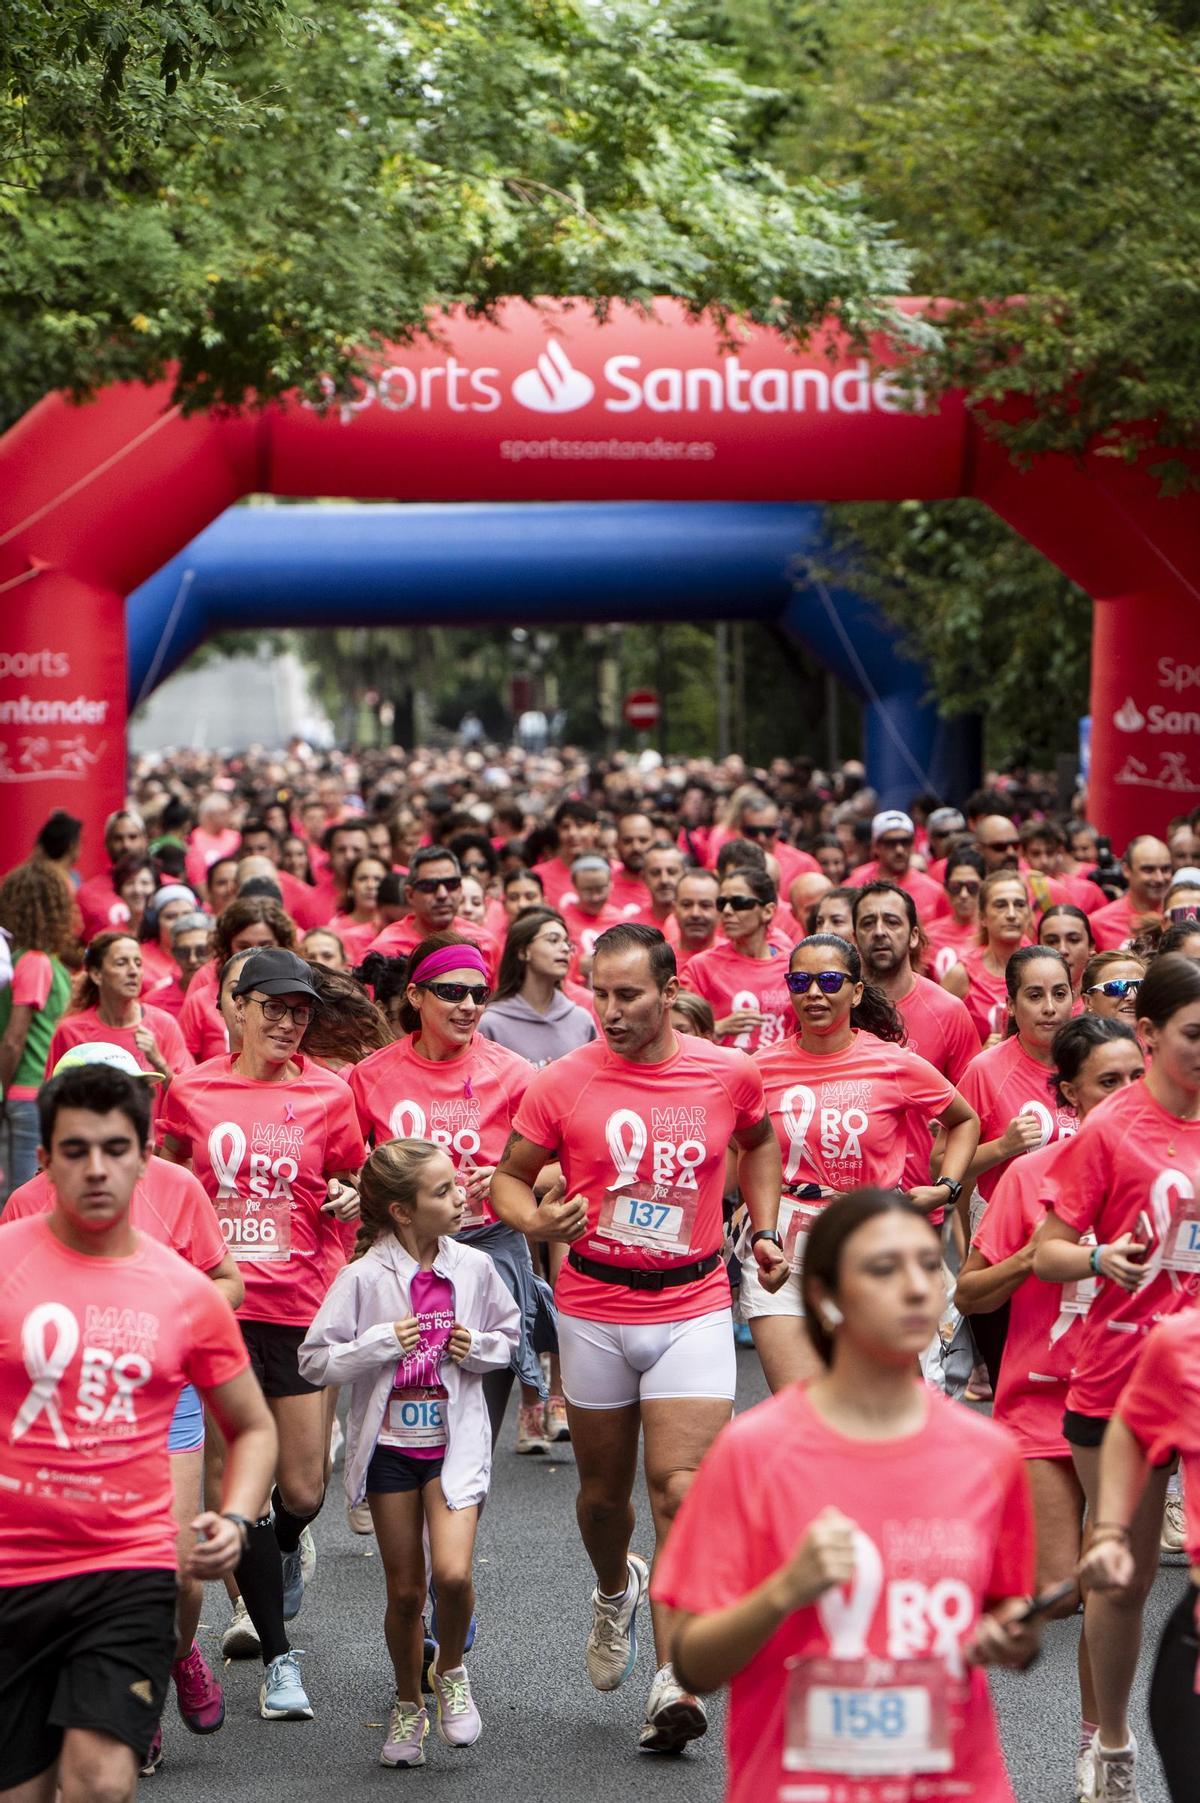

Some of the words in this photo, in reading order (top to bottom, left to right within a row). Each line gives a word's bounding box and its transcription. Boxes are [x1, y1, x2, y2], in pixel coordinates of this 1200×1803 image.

[821, 1080, 873, 1097] MAR
[430, 1098, 480, 1116] MAR
[821, 1095, 869, 1112] CHA
[430, 1114, 480, 1130] CHA
[651, 1106, 706, 1126] MAR
[820, 1108, 868, 1136] RO
[252, 1122, 304, 1145] MAR
[651, 1123, 706, 1142] CHA
[250, 1139, 301, 1160] CHA
[653, 1140, 706, 1169] RO
[821, 1134, 862, 1159] SA
[250, 1154, 298, 1183] RO
[249, 1176, 294, 1200] SA
[628, 1200, 670, 1230] 137
[219, 1218, 276, 1242] 0186
[80, 1347, 152, 1389] RO
[74, 1381, 138, 1423] SA
[829, 1693, 907, 1739] 158
